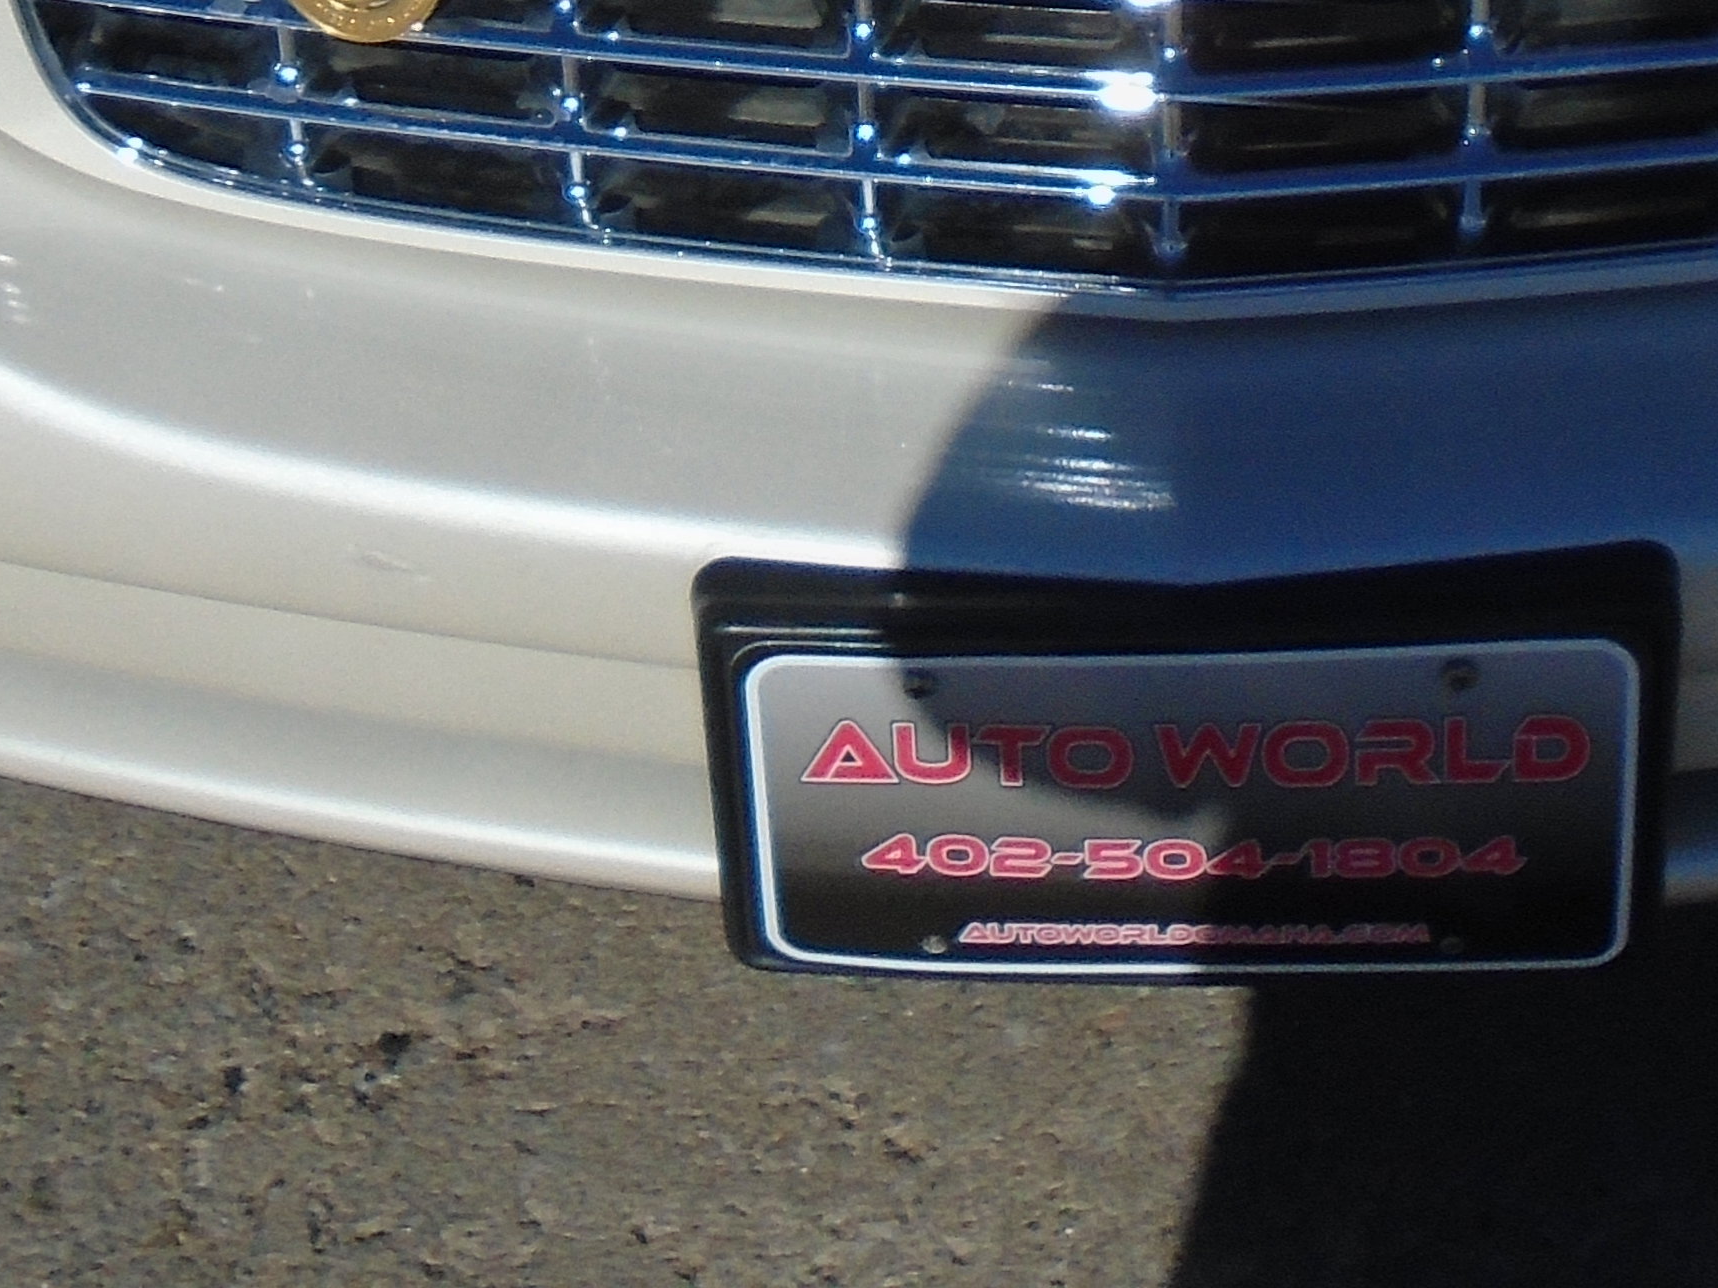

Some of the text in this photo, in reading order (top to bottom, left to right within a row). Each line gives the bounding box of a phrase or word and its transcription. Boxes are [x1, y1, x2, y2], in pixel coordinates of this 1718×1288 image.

[800, 716, 1590, 789] AUTO WORLD
[861, 832, 1528, 881] 402-504-1804
[958, 921, 1432, 946] AUTOWORLDOMAHA.COM
